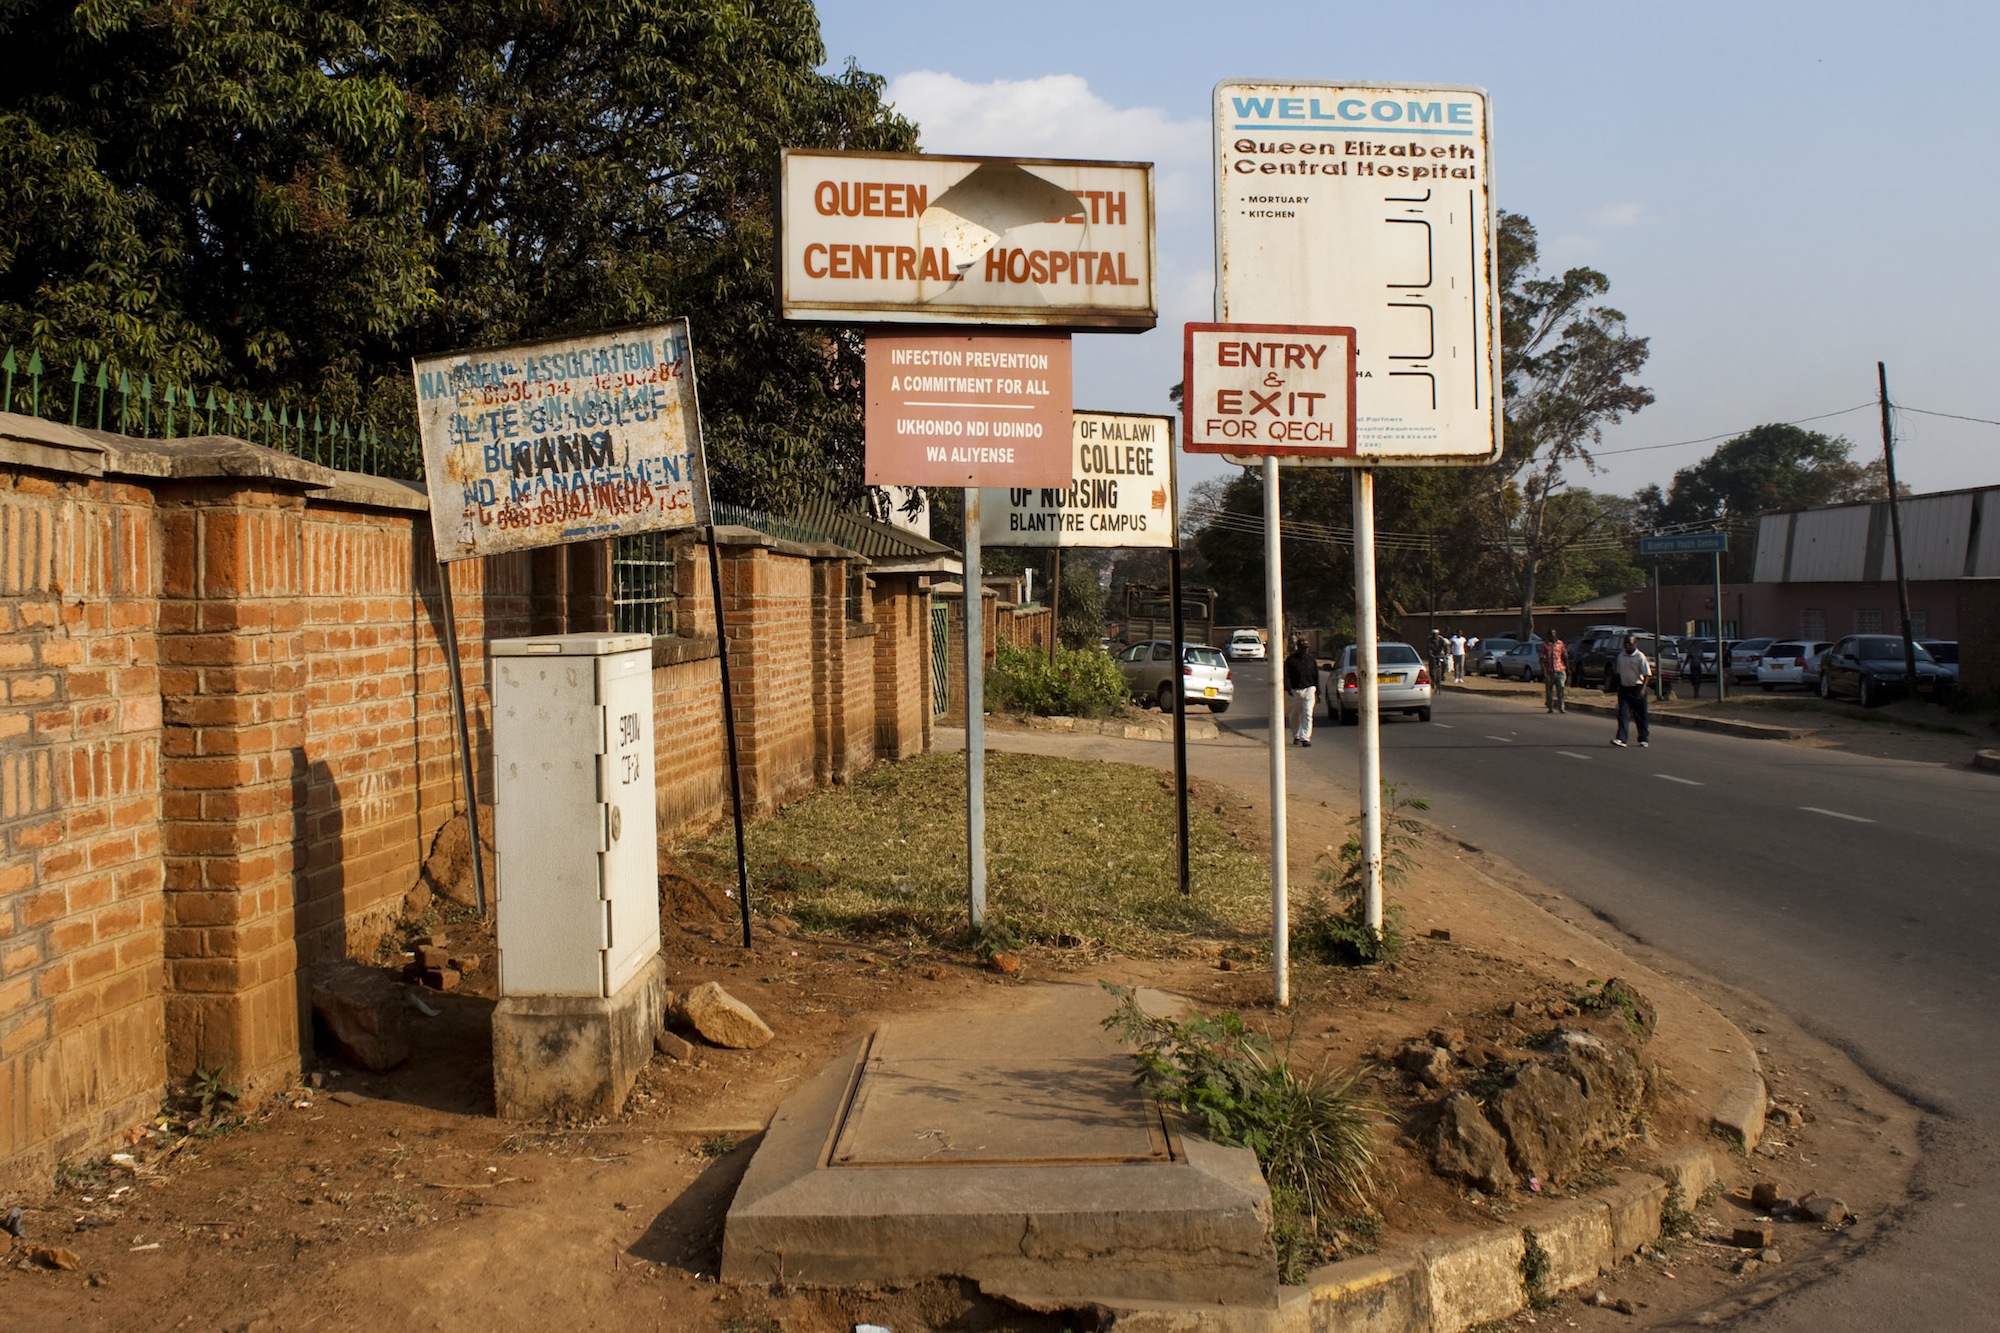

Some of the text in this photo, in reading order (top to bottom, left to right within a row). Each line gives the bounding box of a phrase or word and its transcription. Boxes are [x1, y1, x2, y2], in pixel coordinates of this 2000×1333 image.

[1232, 97, 1473, 124] WELCOME
[1234, 138, 1475, 160] Queen Elizabeth
[1234, 159, 1476, 181] Central Hospital
[814, 180, 927, 218] QUEEN
[1249, 196, 1309, 204] MORTUARY
[1249, 210, 1295, 218] KITCHEN
[803, 243, 1139, 286] CENTRAL HOSPITAL
[526, 340, 656, 385] ASSOCIATION
[662, 335, 690, 366] OF
[891, 350, 1048, 370] INFECTION PREVENTION
[1218, 341, 1327, 369] ENTRY
[891, 376, 1049, 395] A COMMITMENT FOR ALL
[1263, 372, 1285, 388] &
[1217, 389, 1326, 417] EXIT
[897, 419, 1042, 438] UKHONDO NDI UDINDO
[1081, 420, 1155, 443] OF MALAWI
[1206, 419, 1257, 439] FOR
[926, 446, 1014, 463] WA ALIYENSE
[1080, 444, 1154, 476] COLLEGE
[1010, 479, 1118, 509] OF NURSING
[1010, 513, 1147, 532] BLANTYRE CAMPUS
